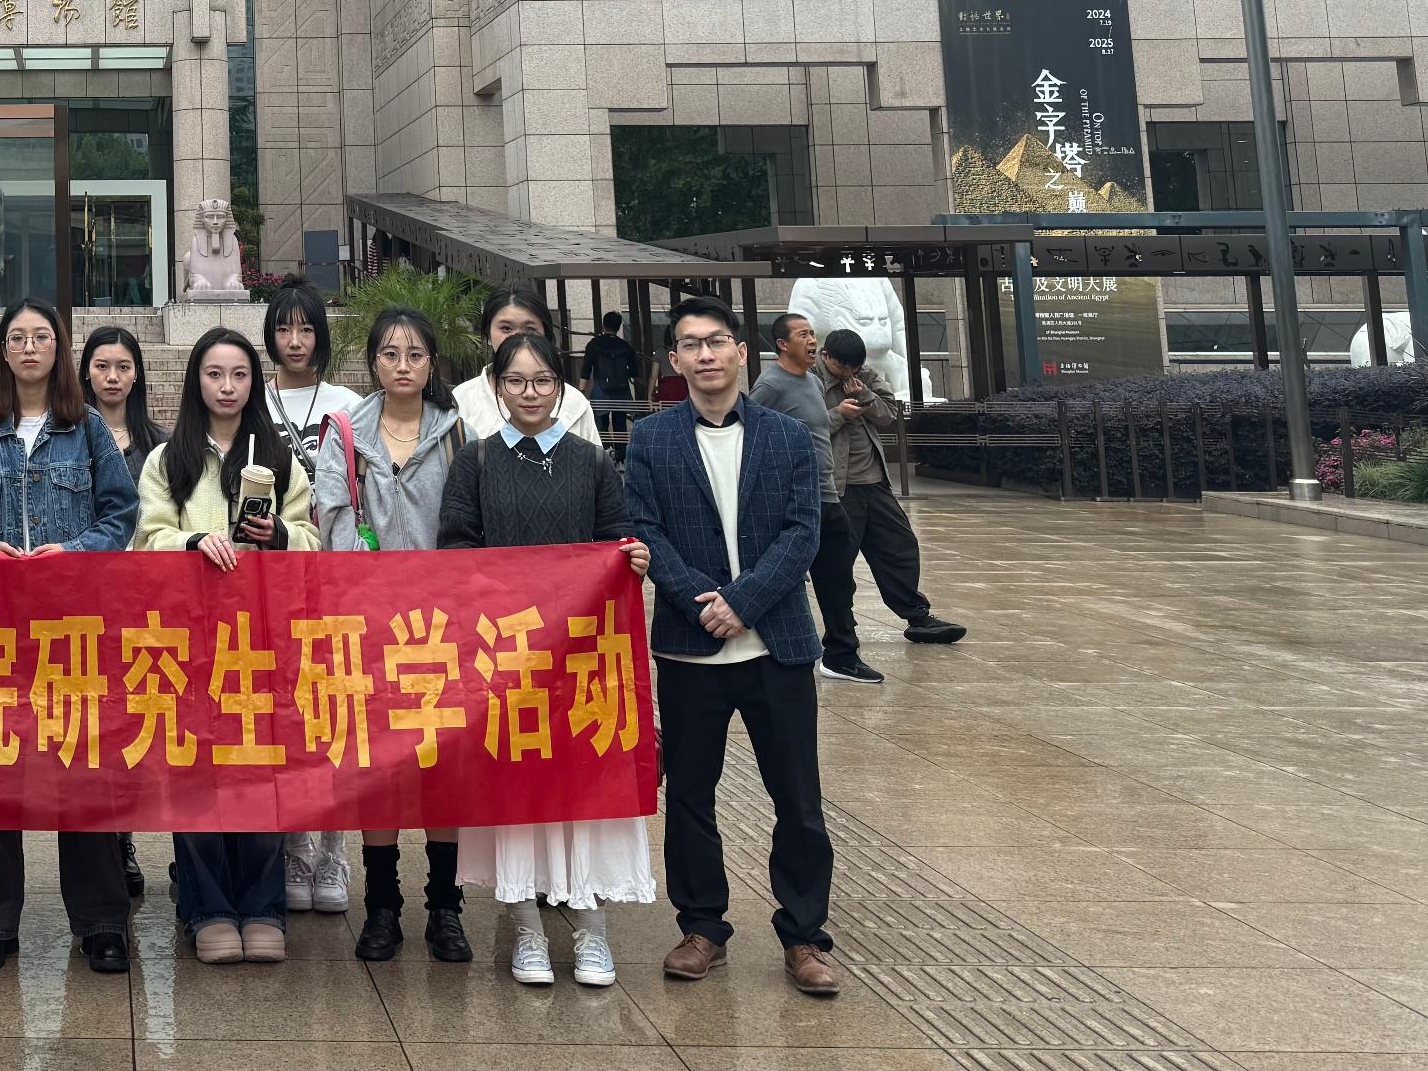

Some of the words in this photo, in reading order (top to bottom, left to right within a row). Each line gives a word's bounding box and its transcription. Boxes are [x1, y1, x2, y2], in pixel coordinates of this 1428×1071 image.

[1086, 9, 1111, 19] 2024
[1088, 39, 1114, 48] 2025
[1079, 88, 1088, 100] OF
[1080, 101, 1090, 118] THE
[1082, 119, 1093, 155] PYRAMID
[1093, 129, 1103, 146] TOP
[1001, 277, 1118, 292] 古及文明大展
[1091, 294, 1109, 302] Egypt
